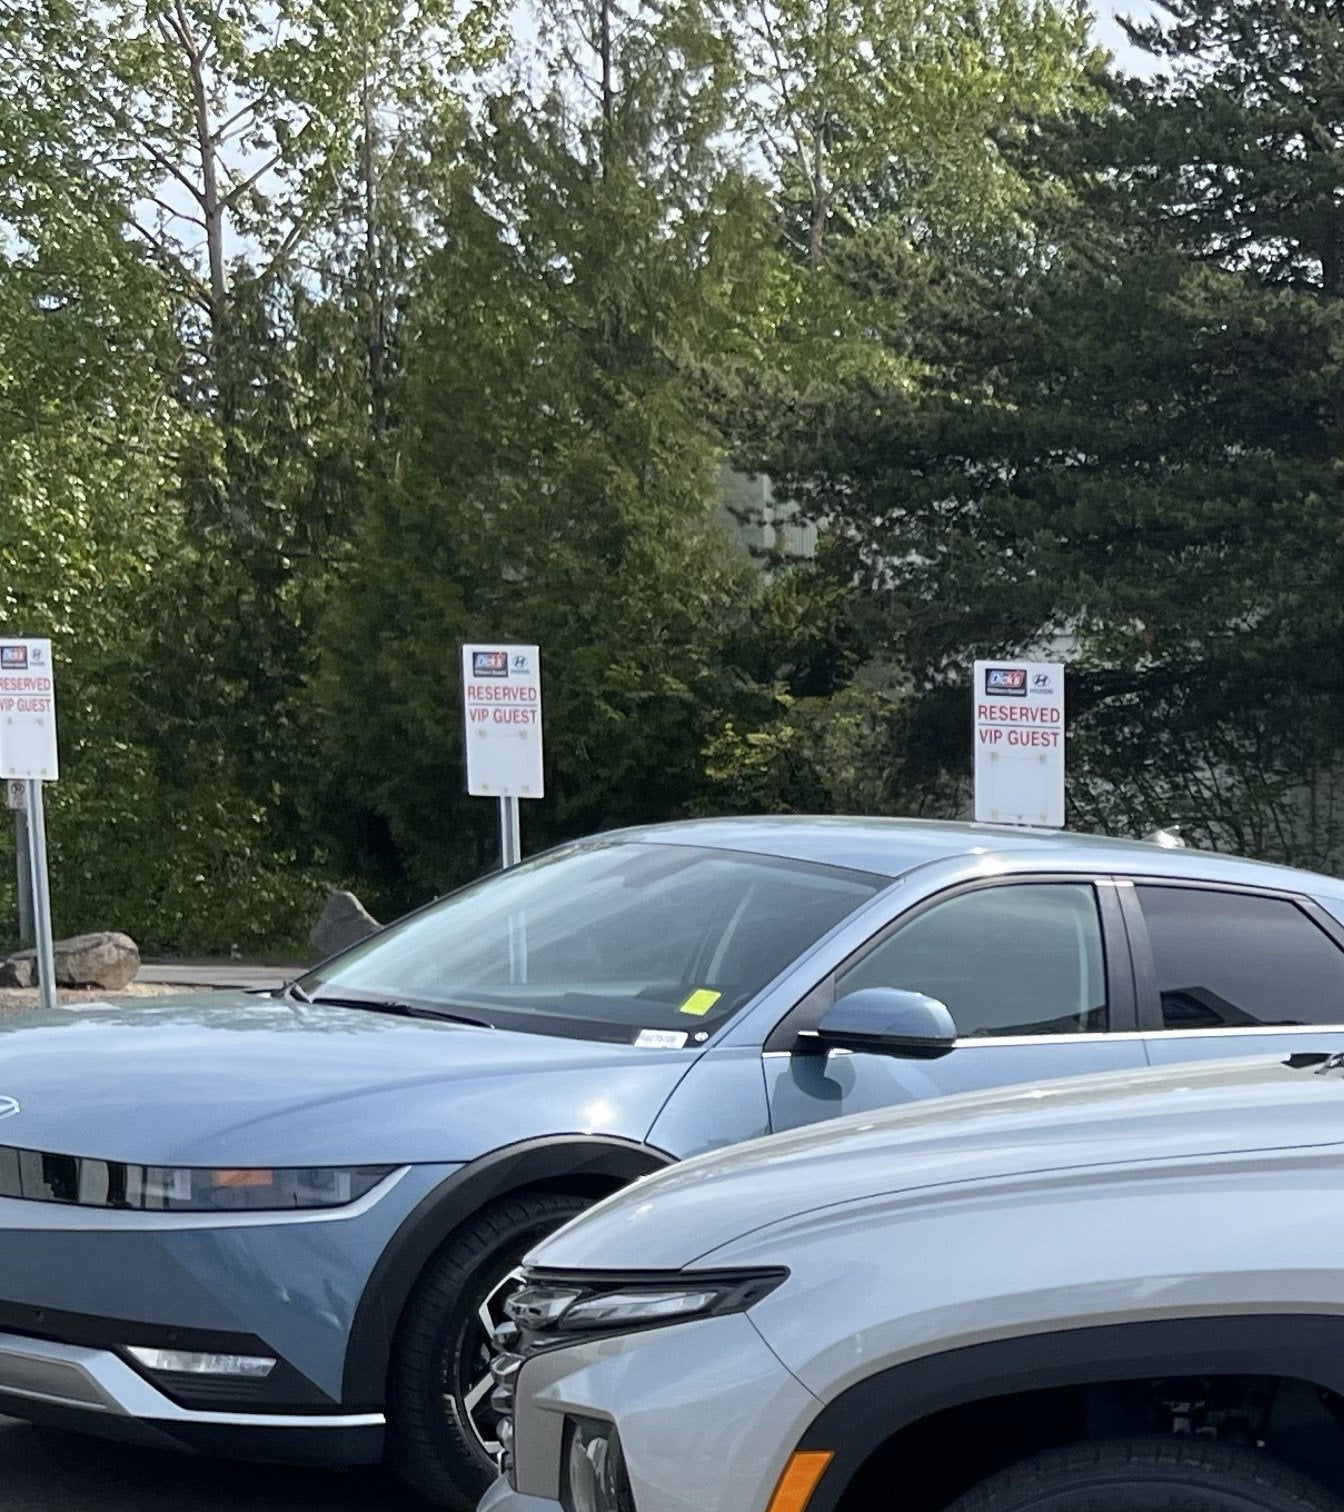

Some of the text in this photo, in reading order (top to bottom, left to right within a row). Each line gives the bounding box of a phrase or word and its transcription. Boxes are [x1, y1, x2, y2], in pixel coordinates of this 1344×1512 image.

[467, 685, 538, 702] RESERVED
[17, 698, 51, 713] GUEST
[978, 704, 1061, 723] RESERVED
[468, 707, 538, 724] VIP GUEST
[978, 728, 1060, 748] VIP GUEST
